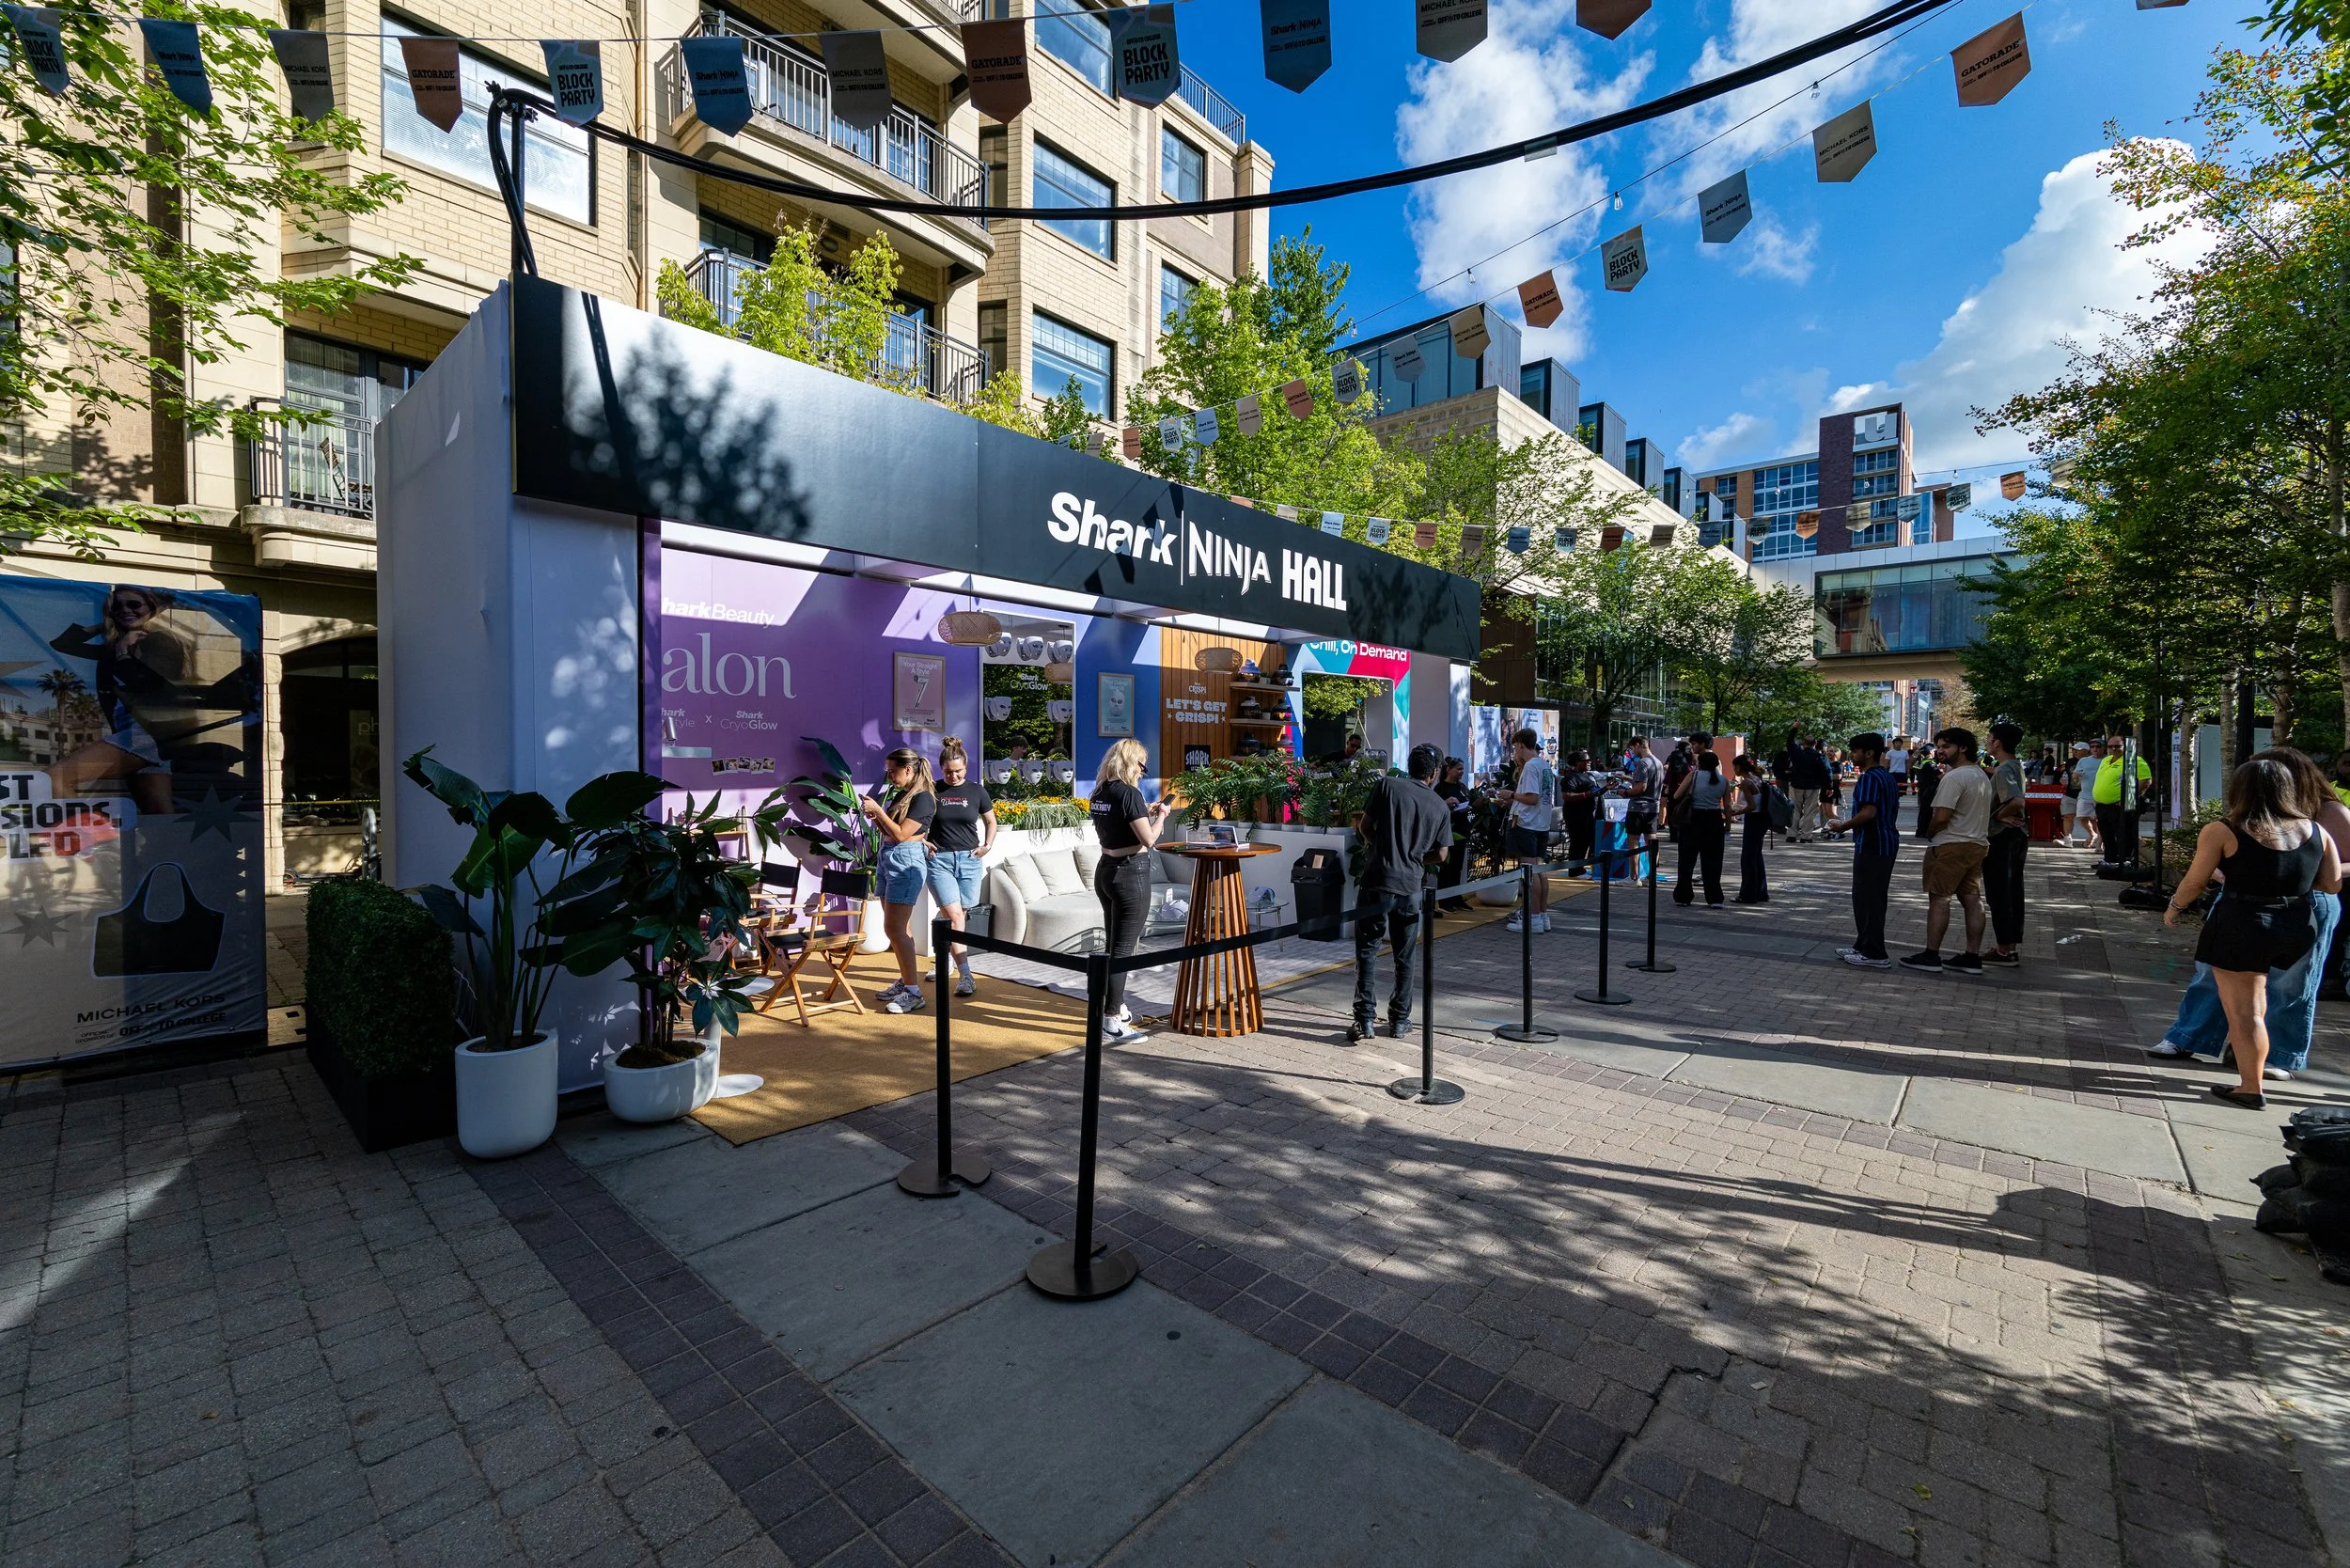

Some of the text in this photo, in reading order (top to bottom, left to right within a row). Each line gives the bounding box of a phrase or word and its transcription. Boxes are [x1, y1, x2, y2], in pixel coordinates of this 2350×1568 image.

[1421, 0, 1456, 12] MICHAEL
[1271, 17, 1323, 36] Shark NINJA
[24, 39, 56, 56] BLOCK
[1123, 42, 1168, 67] BLOCK
[31, 56, 62, 73] PARTY
[971, 55, 1022, 69] GATORADE
[1961, 40, 2020, 77] GATORADE
[412, 69, 456, 79] GATORADE
[556, 72, 594, 90] BLOCK
[832, 68, 884, 78] MICHAEL KORS
[1125, 60, 1170, 86] PARTY
[560, 88, 595, 107] PARTY
[1819, 125, 1869, 157] MICHAEL KORS
[1705, 203, 1724, 217] Shark
[1609, 249, 1638, 272] BLOCK
[1610, 259, 1640, 282] PARTY
[1525, 288, 1555, 306] GATORADE
[1337, 376, 1355, 387] BLOCK
[1338, 383, 1356, 395] PARTY
[1047, 491, 1347, 611] Shark NINJA HALL
[1340, 639, 1357, 655] On
[1359, 643, 1407, 662] Demand
[661, 632, 797, 698] alon
[916, 662, 938, 670] Straight
[1010, 679, 1049, 691] CryoGlow
[1166, 698, 1227, 713] LET'S GET
[673, 717, 695, 729] tyle
[735, 711, 763, 719] Shark
[1175, 711, 1219, 724] CRISPI
[720, 718, 778, 731] CryoGlow
[1185, 749, 1210, 765] SHARK
[0, 831, 81, 859] LED
[77, 993, 226, 1024] MICHAEL KORS
[75, 1035, 106, 1044] SPONSOR
[80, 1029, 109, 1038] OFFICIAL
